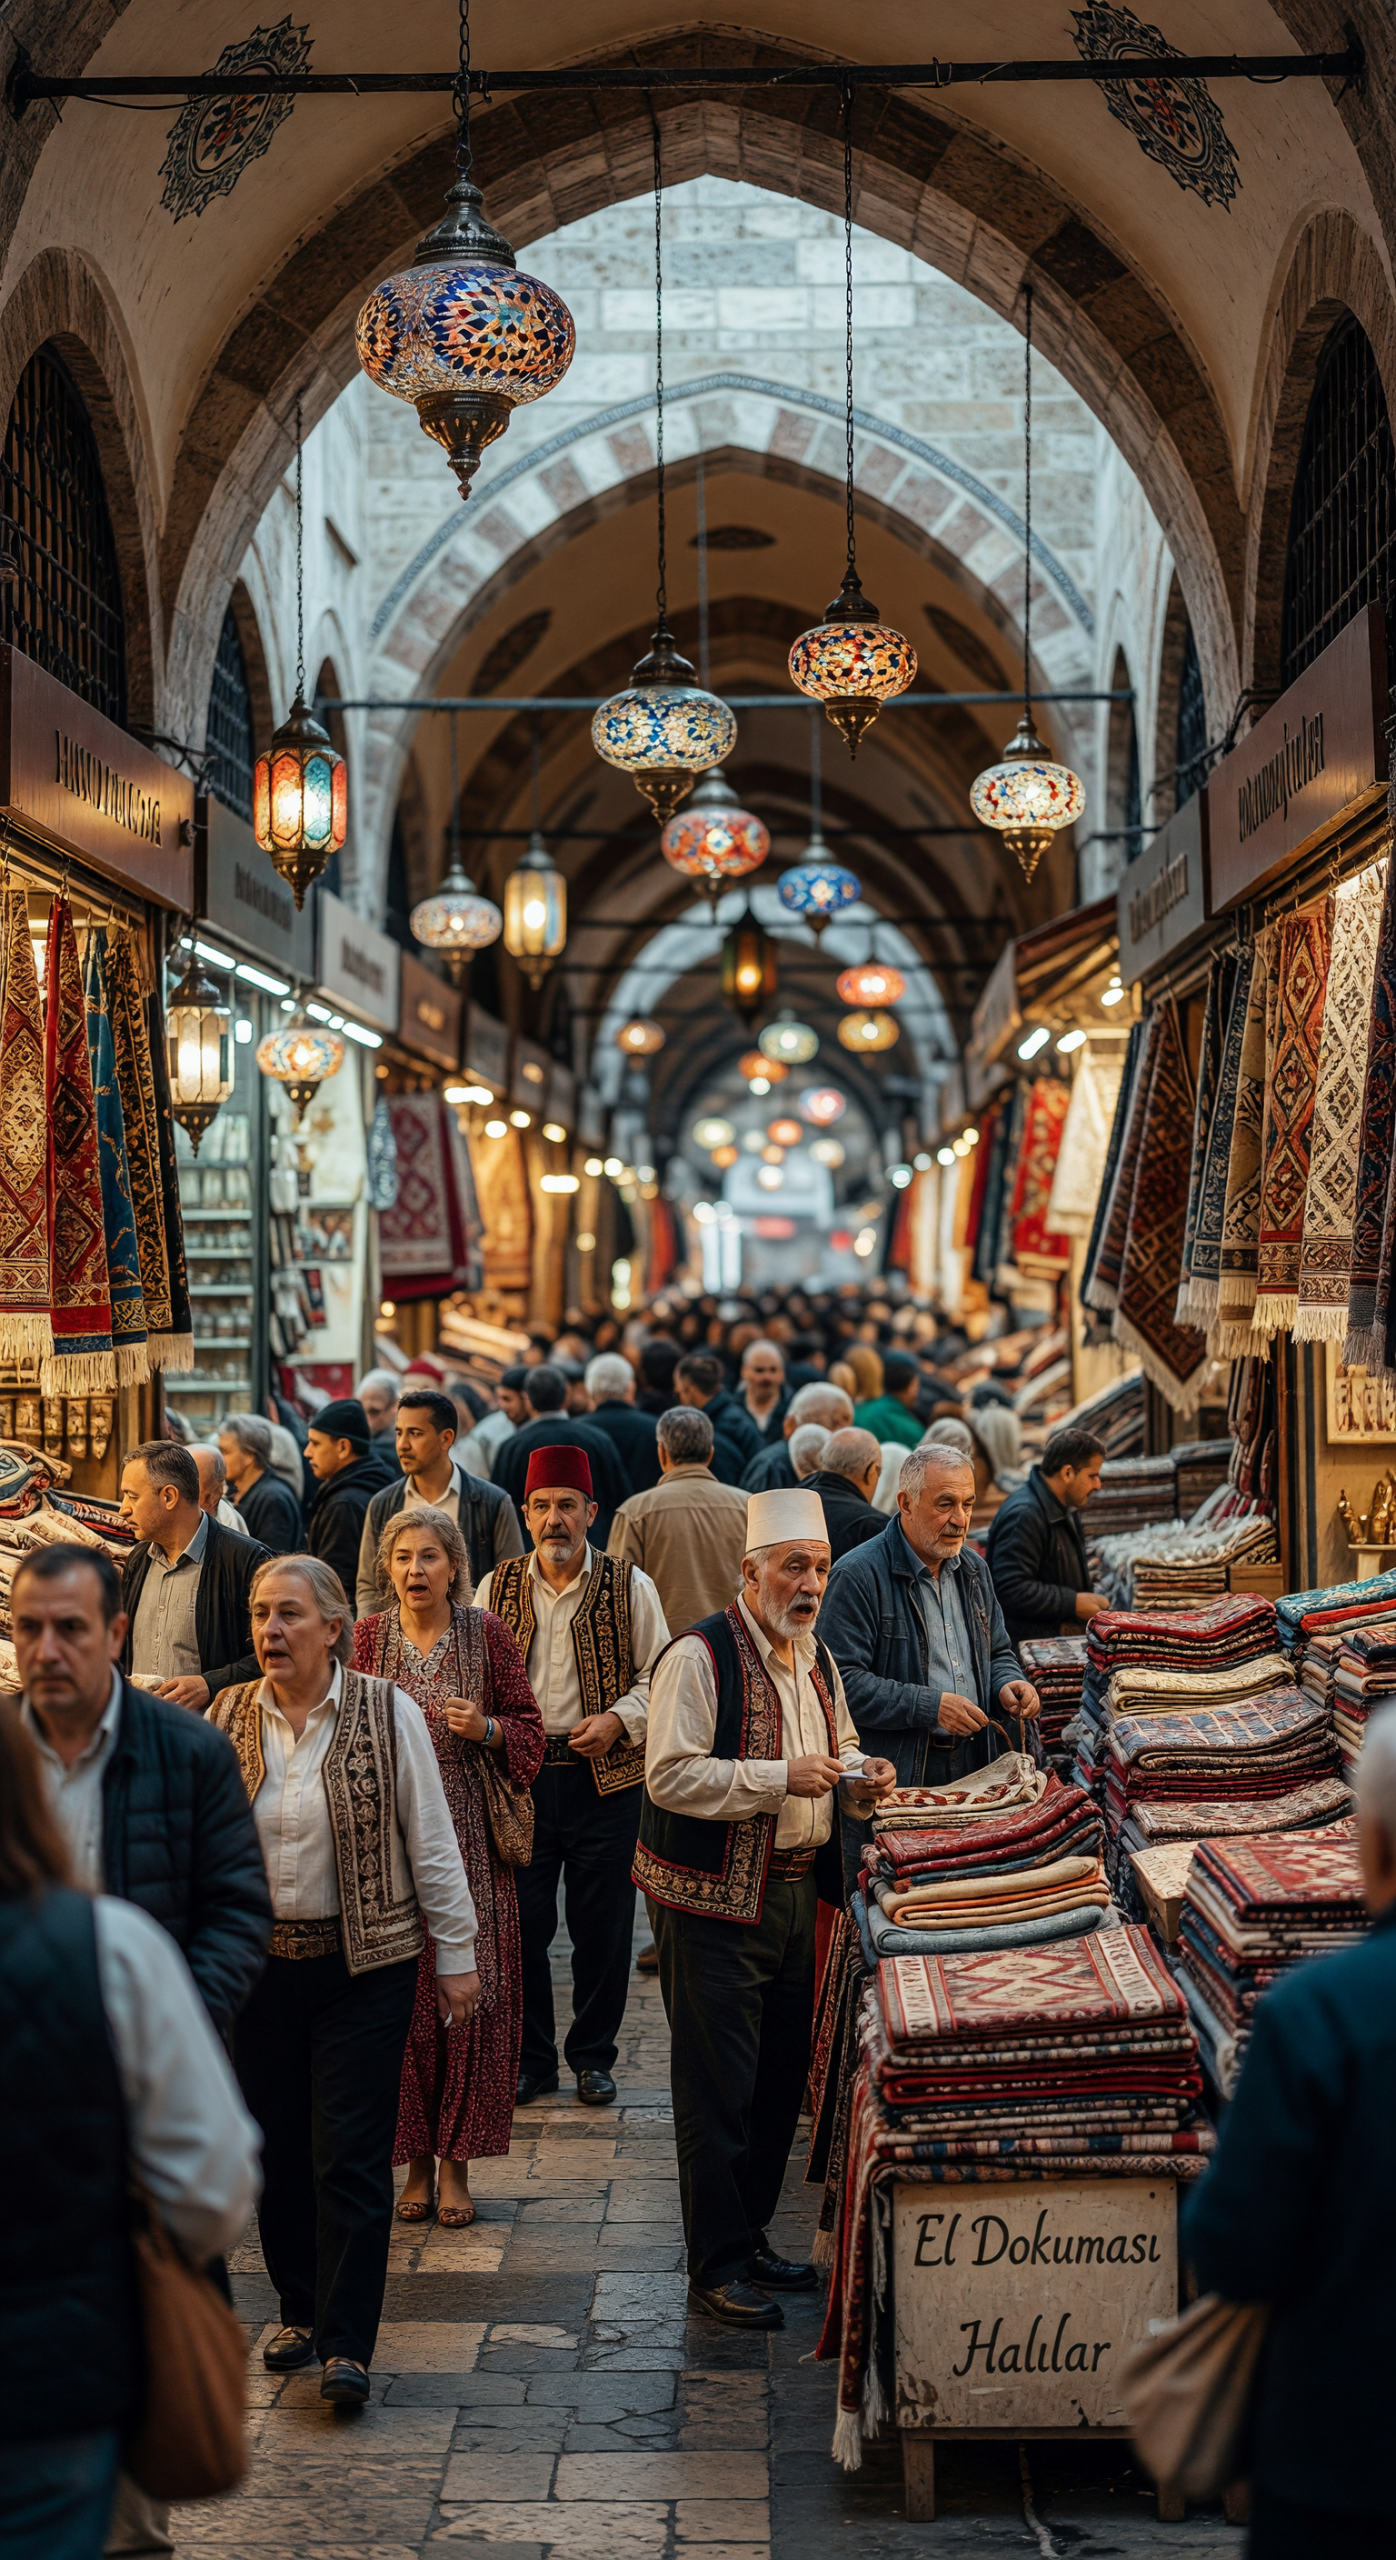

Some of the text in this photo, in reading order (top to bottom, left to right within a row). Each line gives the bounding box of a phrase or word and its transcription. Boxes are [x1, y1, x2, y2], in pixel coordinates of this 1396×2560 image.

[914, 2208, 1162, 2267] El Dokuması
[952, 2312, 1112, 2377] Halılar
